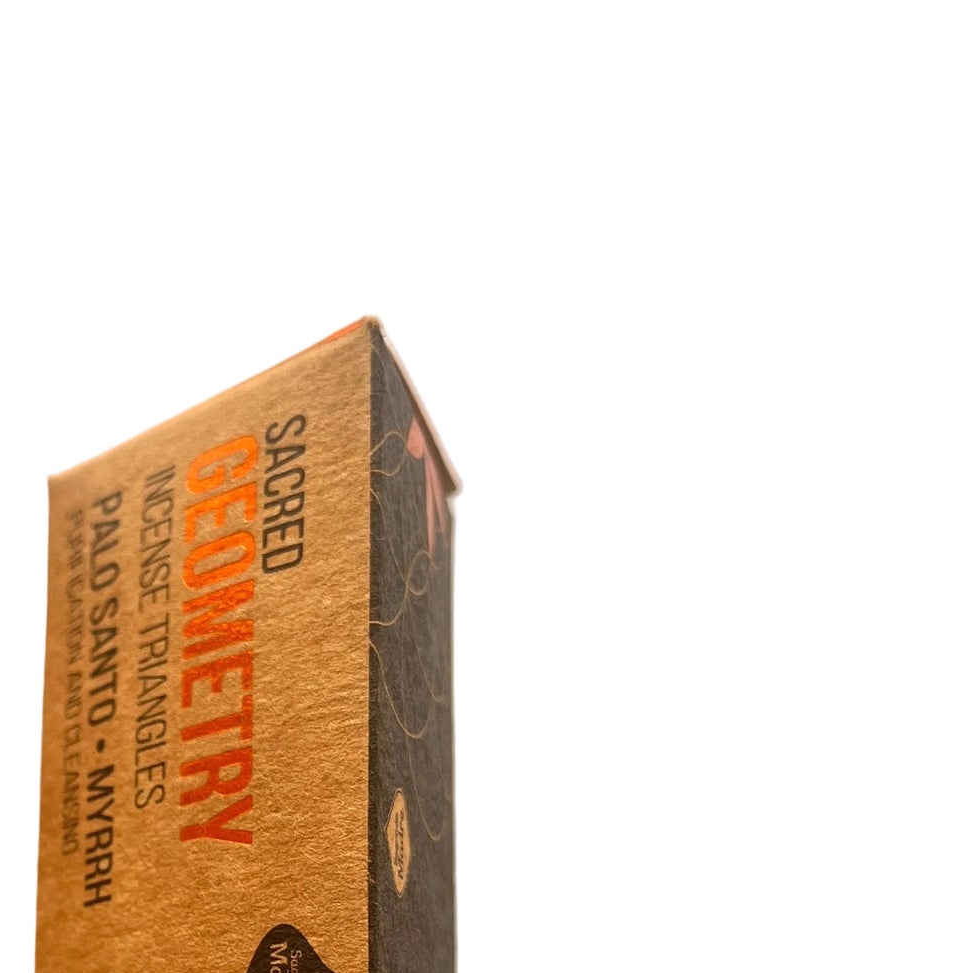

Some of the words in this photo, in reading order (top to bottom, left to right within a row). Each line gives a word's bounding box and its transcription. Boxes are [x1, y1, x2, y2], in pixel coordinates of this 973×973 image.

[89, 490, 124, 592] PALO
[137, 463, 175, 612] INCENSE
[262, 412, 307, 575] SACRED
[87, 596, 120, 728] SANTO
[134, 612, 171, 811] TRIANGLES
[179, 434, 259, 847] GEOMETRY
[83, 761, 117, 910] MYRRH
